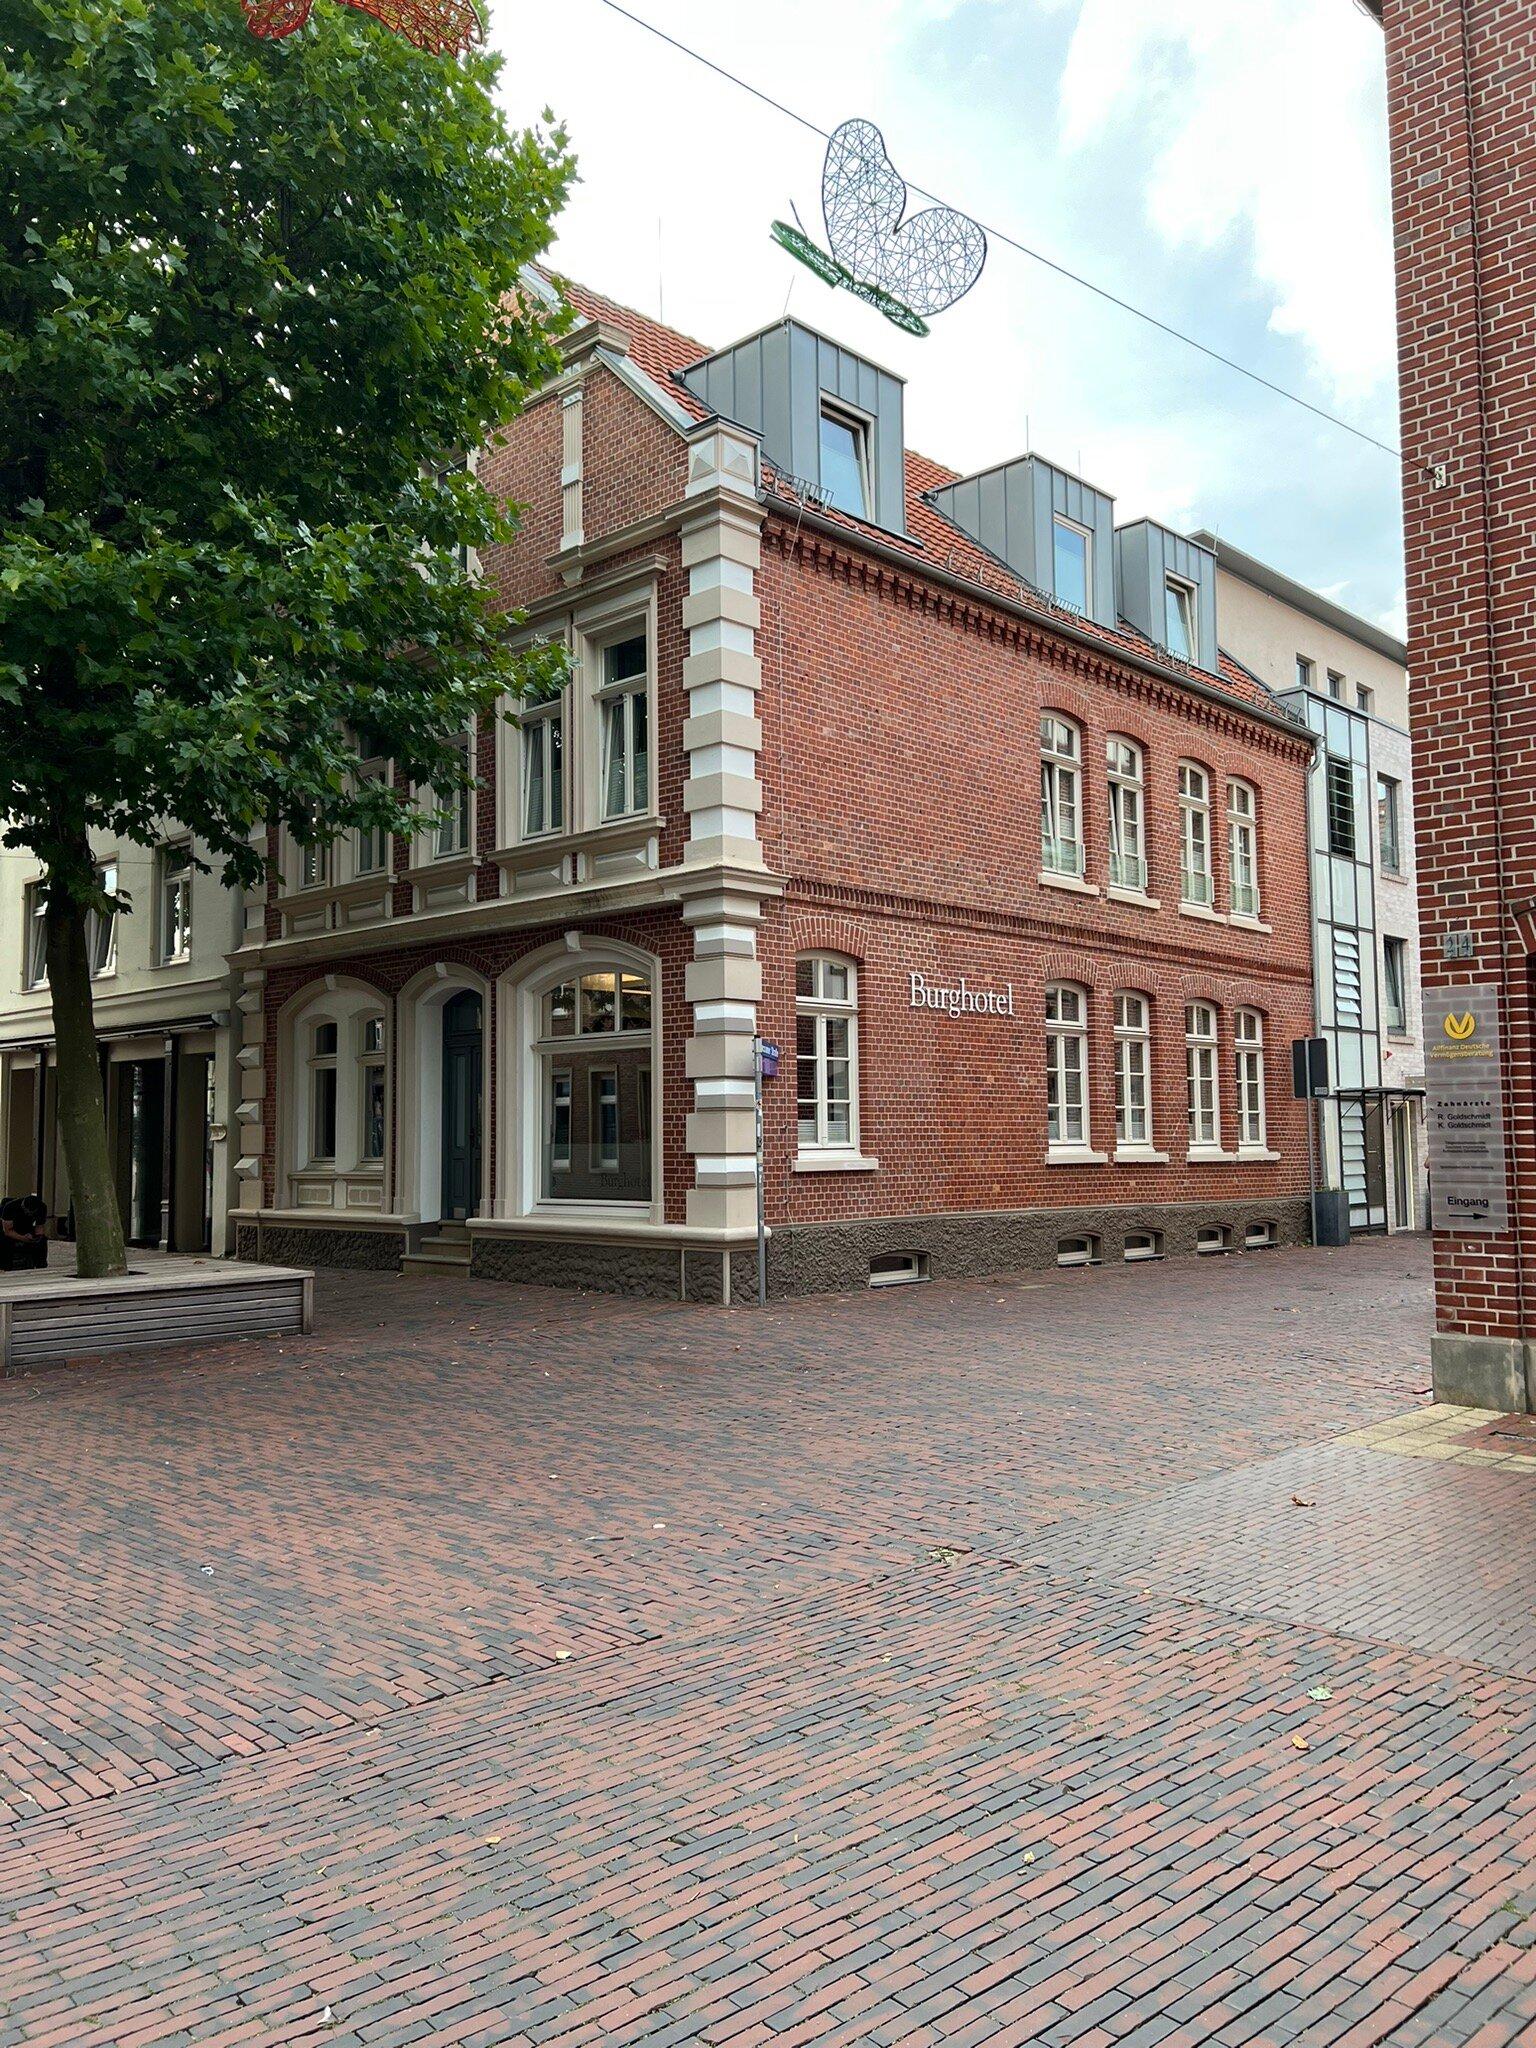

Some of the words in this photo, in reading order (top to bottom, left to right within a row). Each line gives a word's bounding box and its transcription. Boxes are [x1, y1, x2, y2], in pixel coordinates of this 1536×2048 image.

[1446, 935, 1470, 953] 24
[909, 972, 1015, 1019] Burghotel
[1447, 1196, 1489, 1208] Eingang
